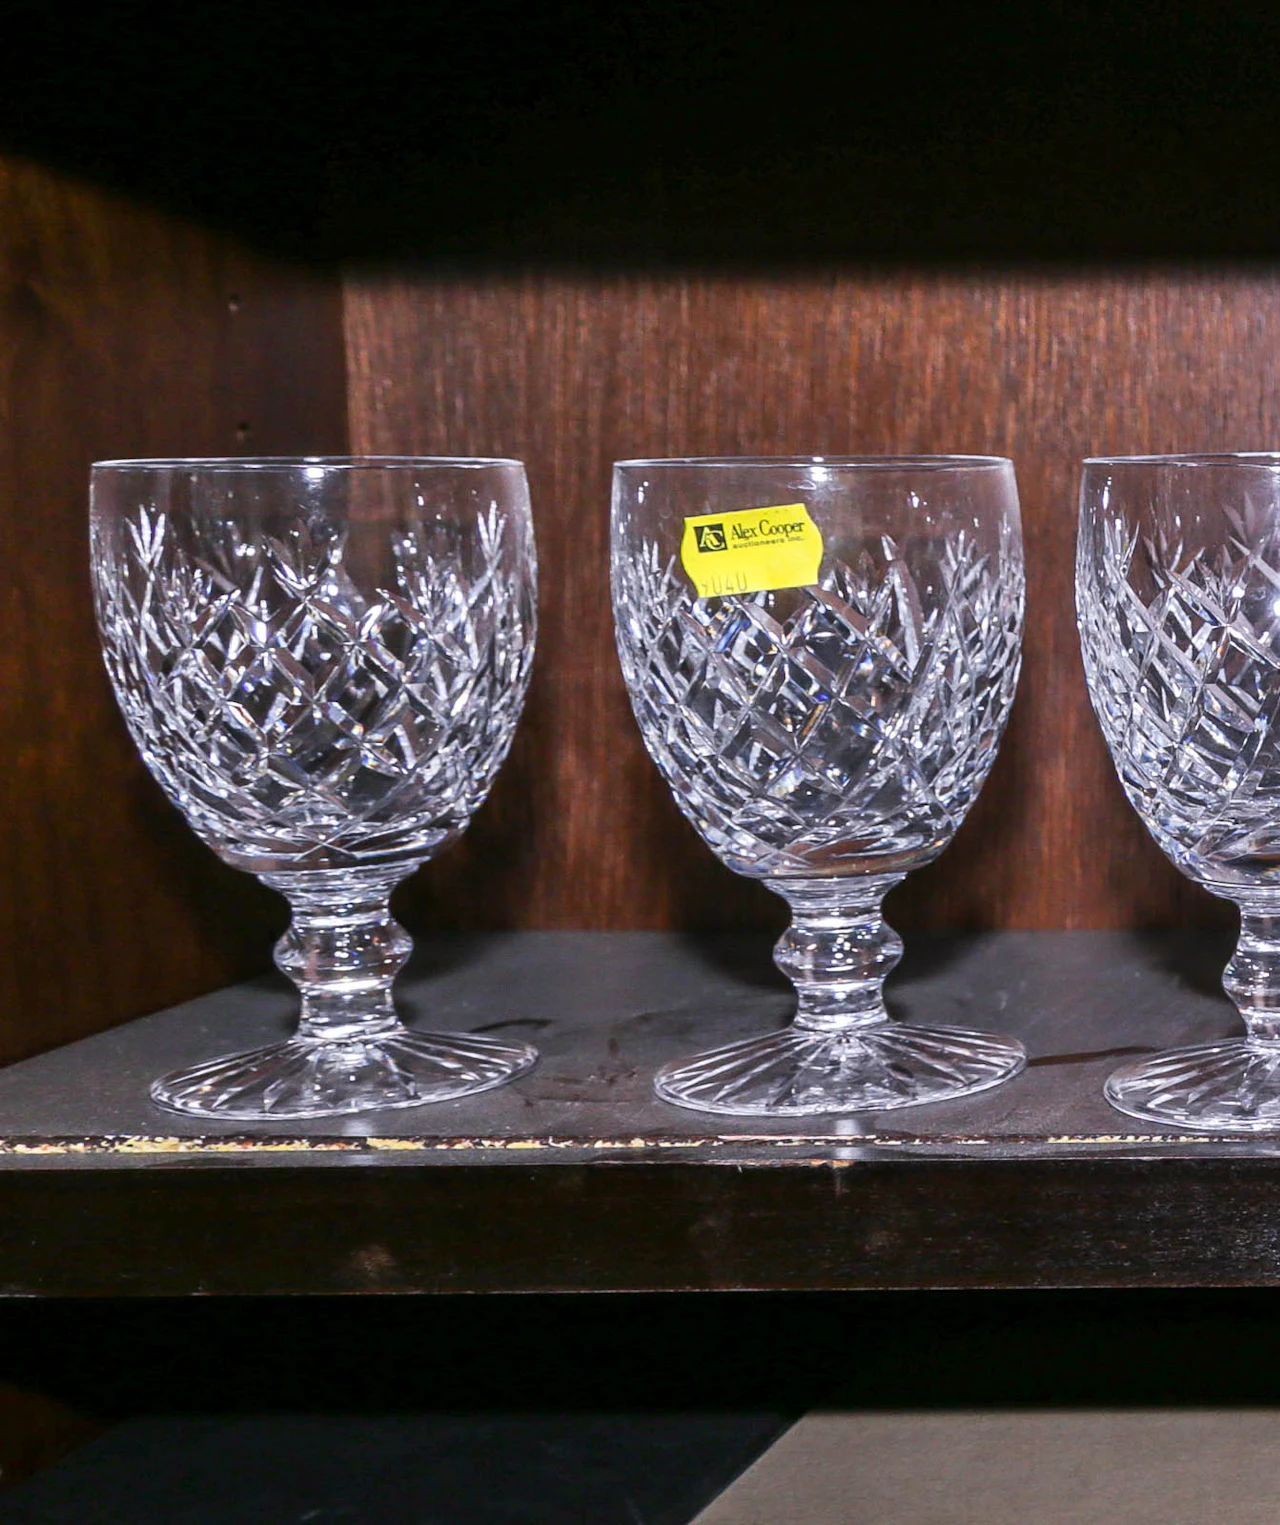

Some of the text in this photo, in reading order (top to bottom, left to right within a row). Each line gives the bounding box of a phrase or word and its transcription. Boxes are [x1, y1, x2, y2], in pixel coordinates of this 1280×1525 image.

[731, 519, 805, 541] Alex Cooper
[732, 537, 785, 549] auctioneers
